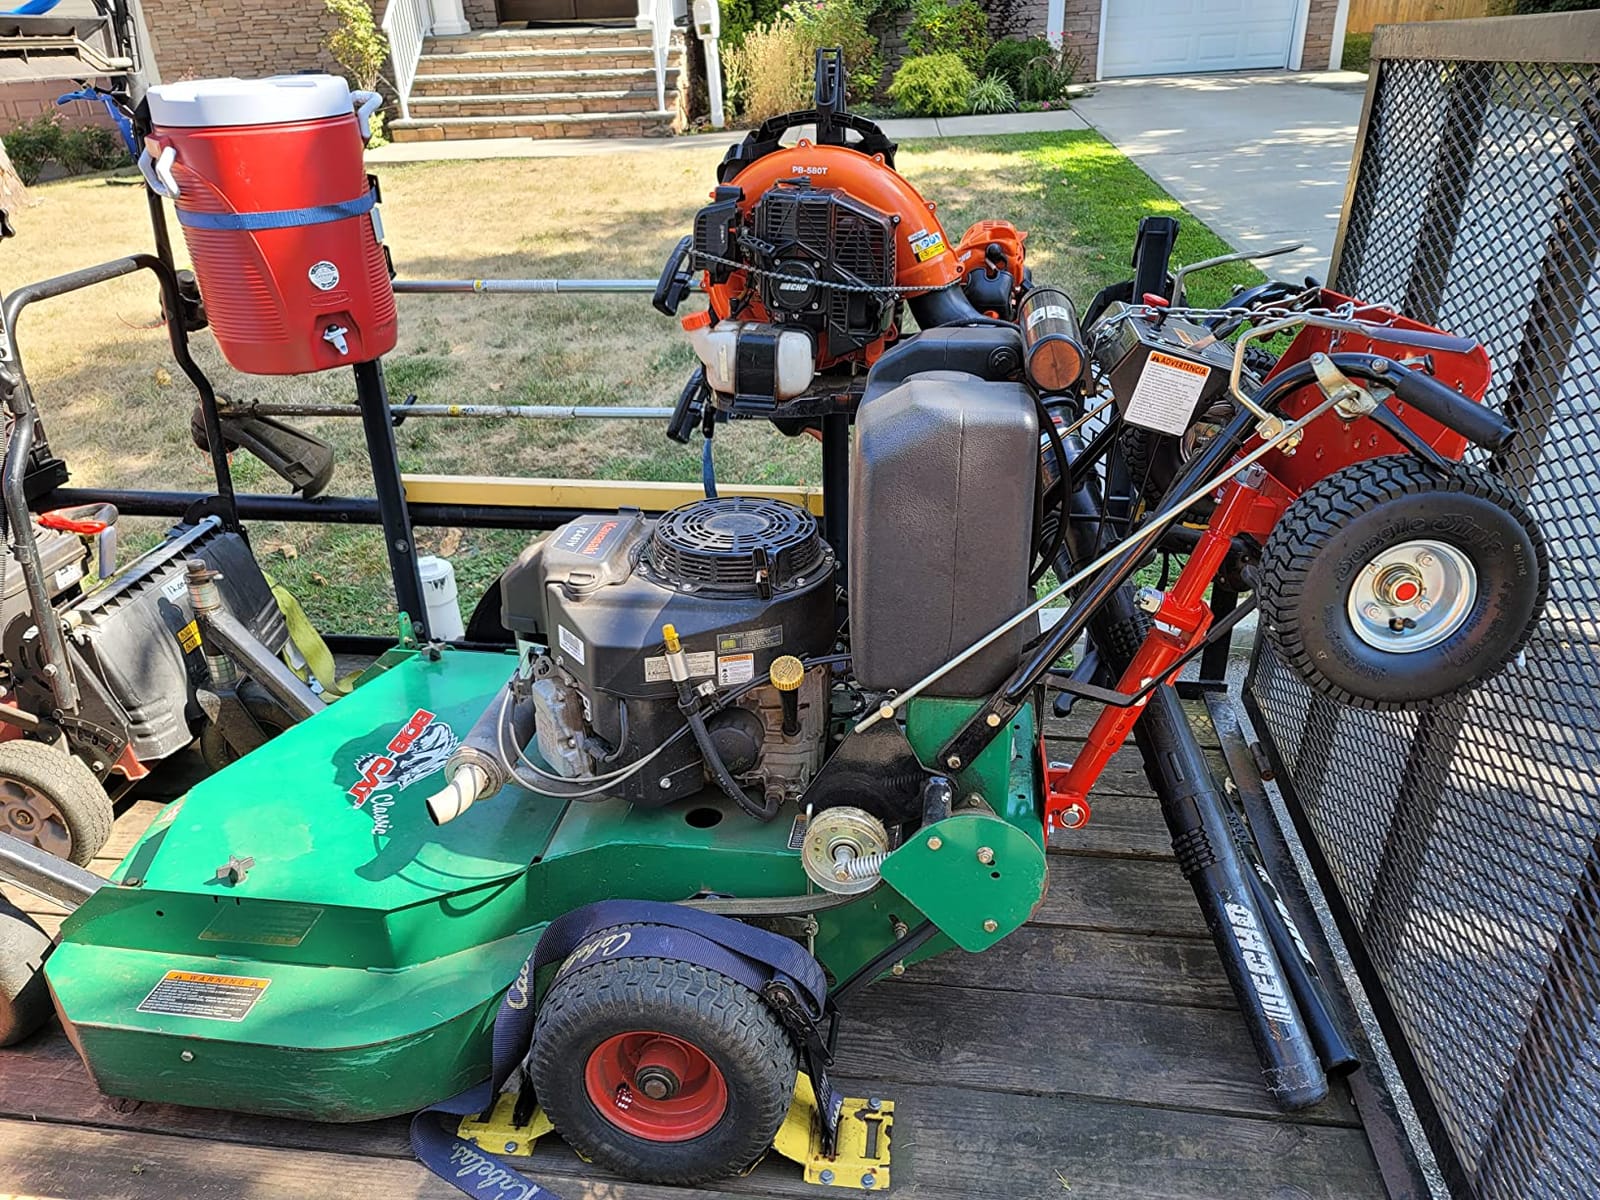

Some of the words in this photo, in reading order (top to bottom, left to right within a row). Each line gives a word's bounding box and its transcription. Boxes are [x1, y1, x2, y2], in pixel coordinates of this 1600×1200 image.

[791, 165, 829, 176] PB-580T
[1160, 356, 1208, 377] ADVERTENCIA
[369, 793, 396, 835] Classic
[1223, 901, 1286, 1000] ECHO
[189, 973, 246, 987] WARNING
